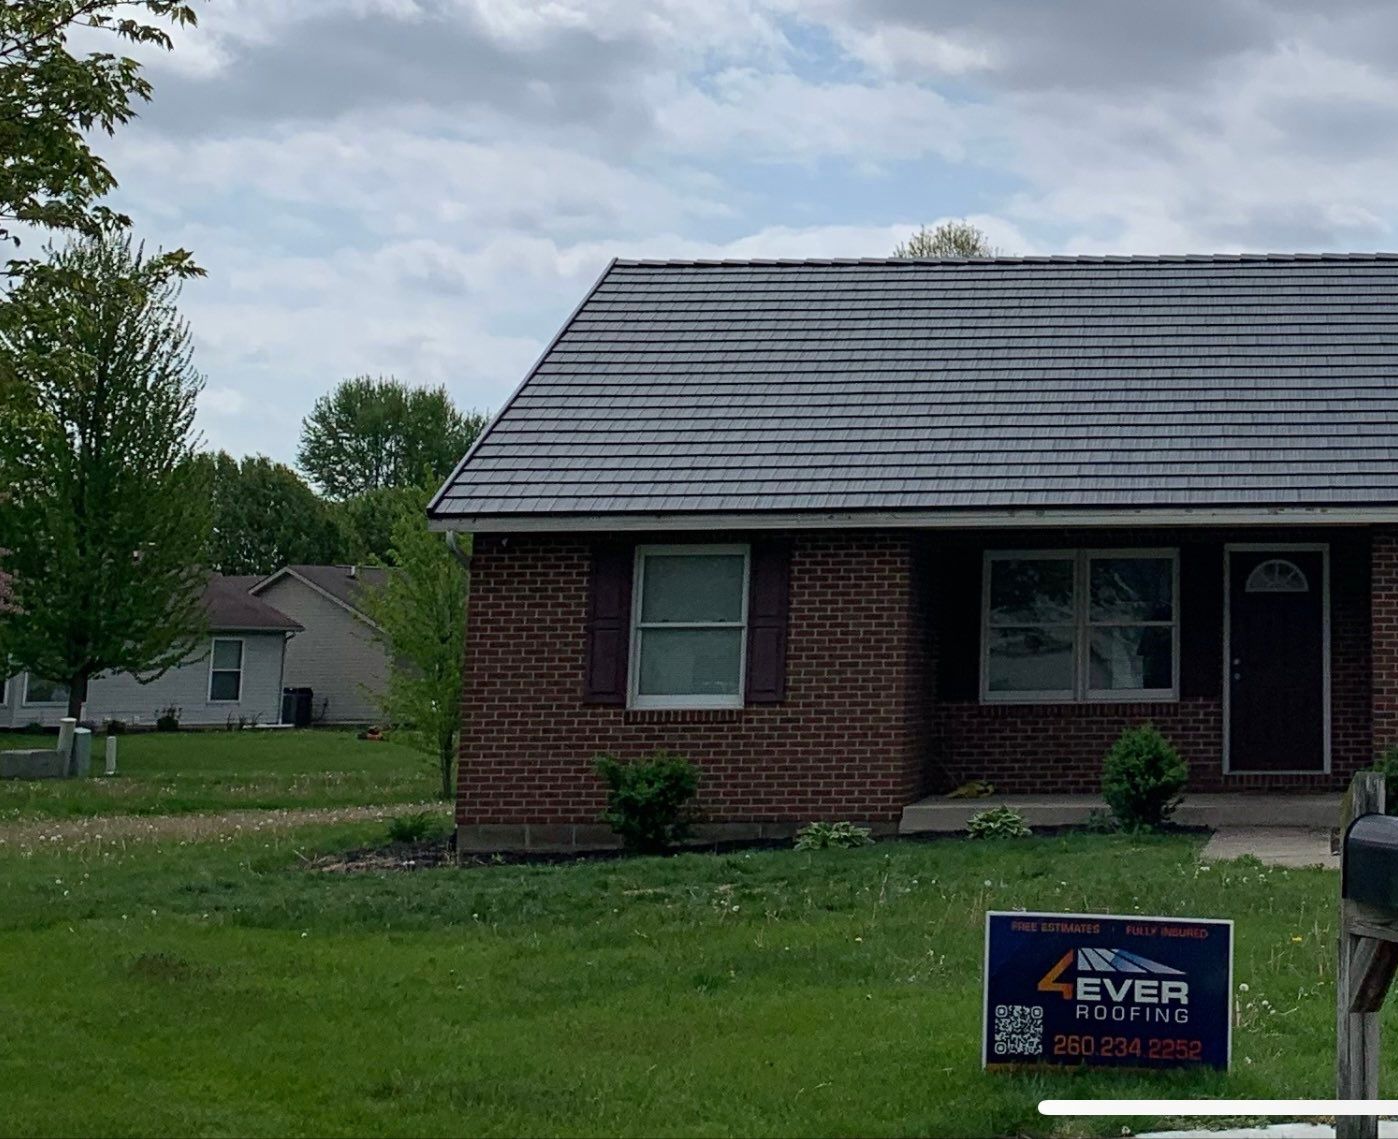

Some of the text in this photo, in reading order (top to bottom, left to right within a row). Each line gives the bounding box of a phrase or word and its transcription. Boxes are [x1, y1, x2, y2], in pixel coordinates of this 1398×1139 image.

[1011, 920, 1100, 935] FREE ESTIMATES
[1126, 925, 1209, 939] FULLY INSURED
[1037, 948, 1189, 1004] 4EVER
[1076, 1004, 1189, 1024] ROOFING
[1053, 1034, 1202, 1060] 260.234.2252
